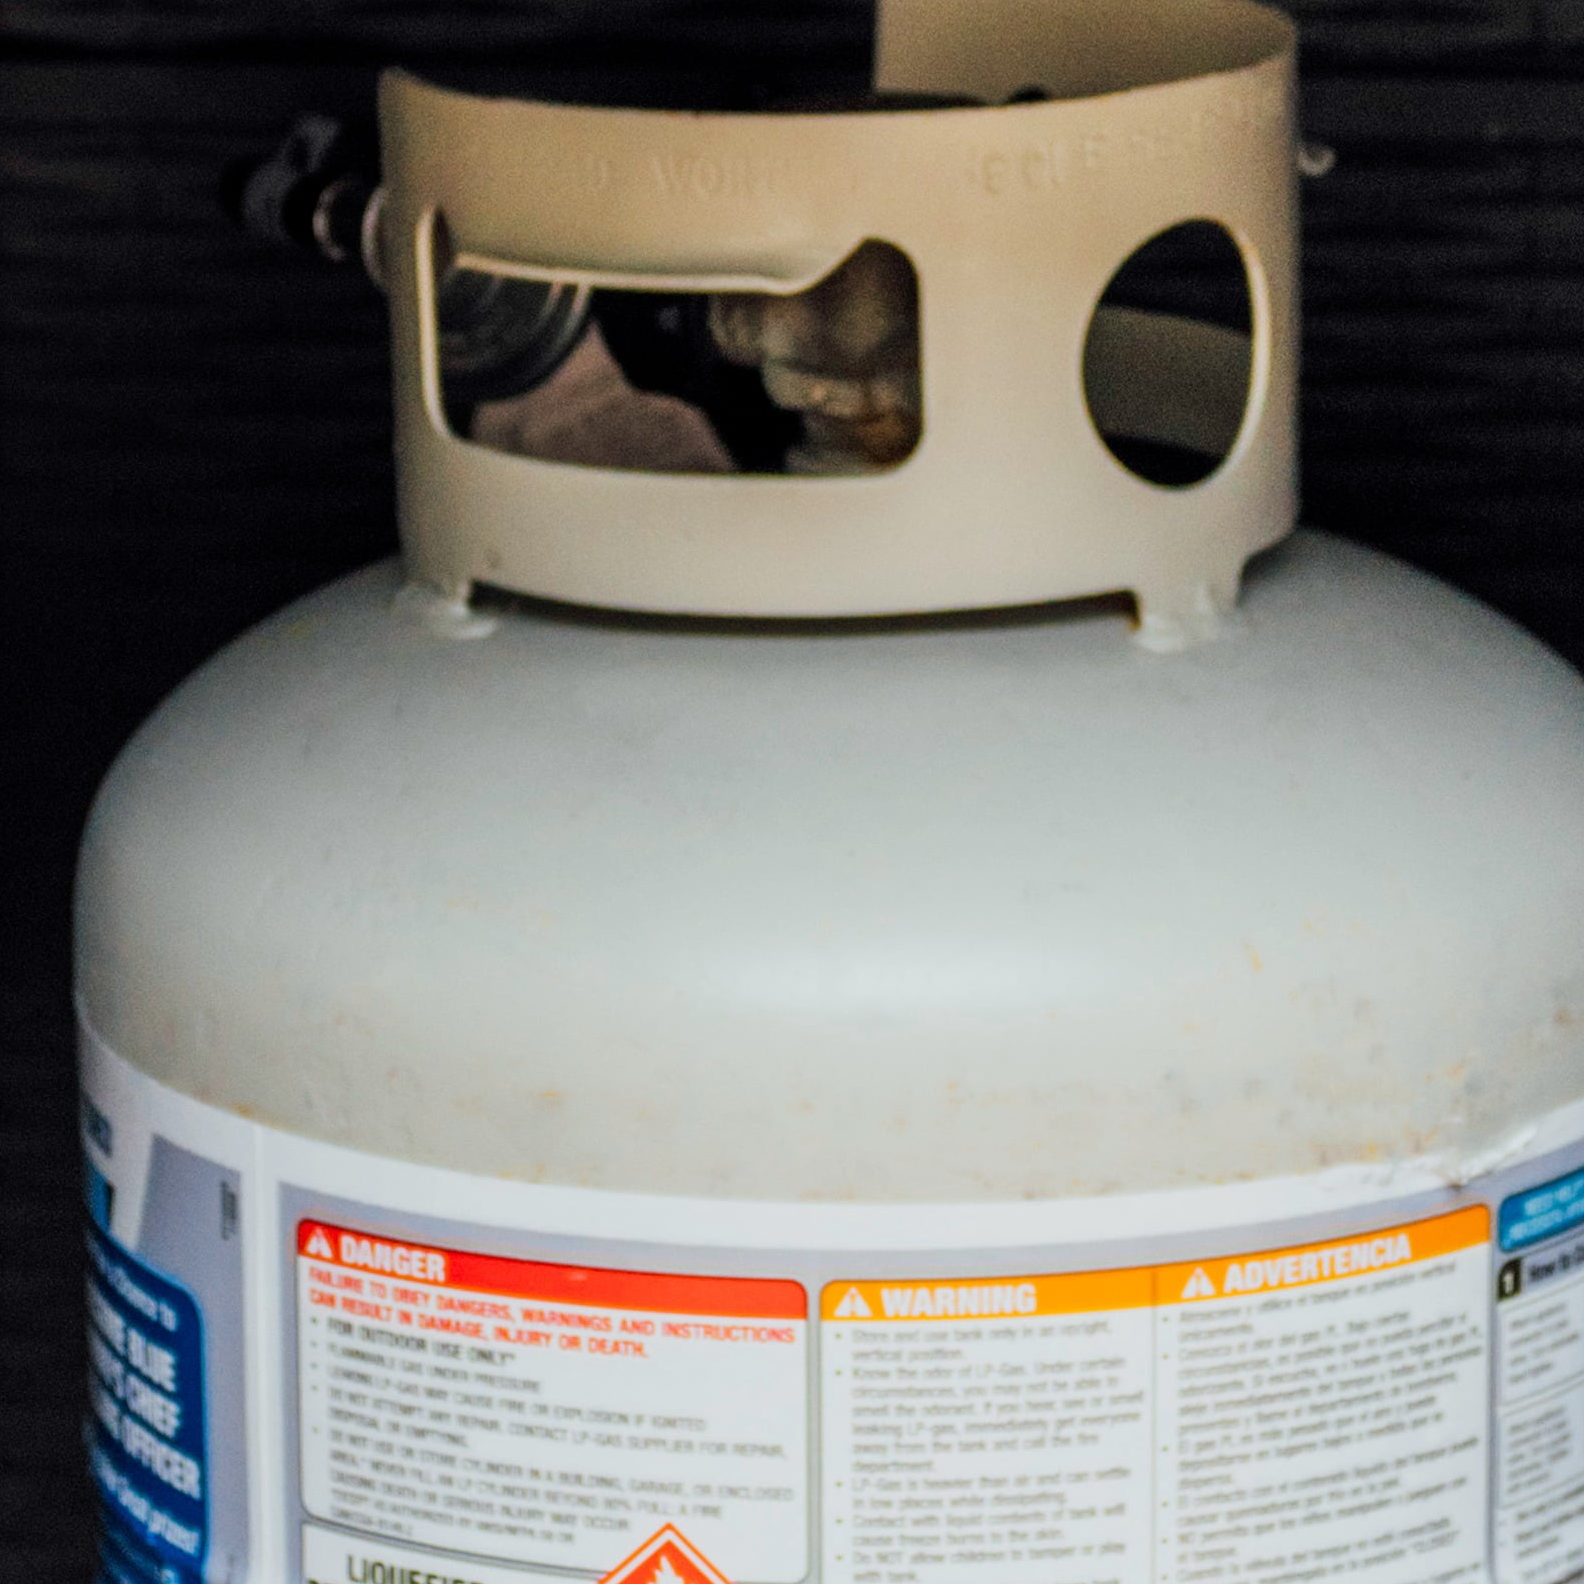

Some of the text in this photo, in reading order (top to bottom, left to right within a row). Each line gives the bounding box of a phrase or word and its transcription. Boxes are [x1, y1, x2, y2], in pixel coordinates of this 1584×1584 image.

[339, 1234, 445, 1282] DANGER
[1223, 1233, 1412, 1293] ADVERTENCIA
[309, 1265, 363, 1294] FAILURE
[369, 1280, 387, 1299] TO
[436, 1294, 515, 1322] DANGERS,
[521, 1307, 611, 1331] WARNINGS
[619, 1318, 655, 1335] AND
[662, 1319, 794, 1344] INSTRUCTIONS
[340, 1295, 391, 1322] RESULT
[397, 1309, 412, 1325] IN
[418, 1313, 487, 1340] DAMAGE,
[493, 1325, 551, 1347] INJURY
[558, 1333, 581, 1350] OR
[587, 1336, 648, 1359] DEATH.
[881, 1283, 1037, 1317] WARNING
